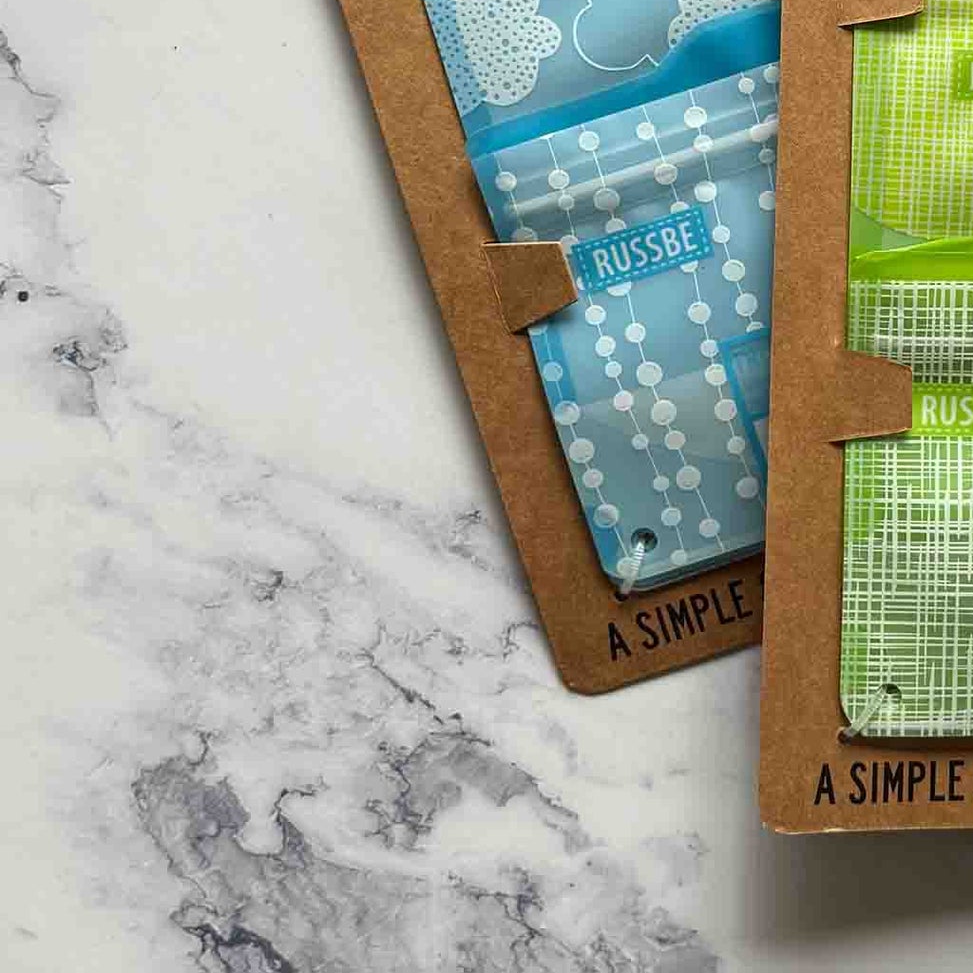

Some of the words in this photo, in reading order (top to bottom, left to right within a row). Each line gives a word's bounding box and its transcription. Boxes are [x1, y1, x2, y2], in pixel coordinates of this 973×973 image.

[592, 222, 700, 275] RUSSBE
[607, 621, 632, 662] A
[635, 578, 754, 650] SIMPLE
[813, 761, 836, 805] A
[848, 759, 965, 804] SIMPLE
